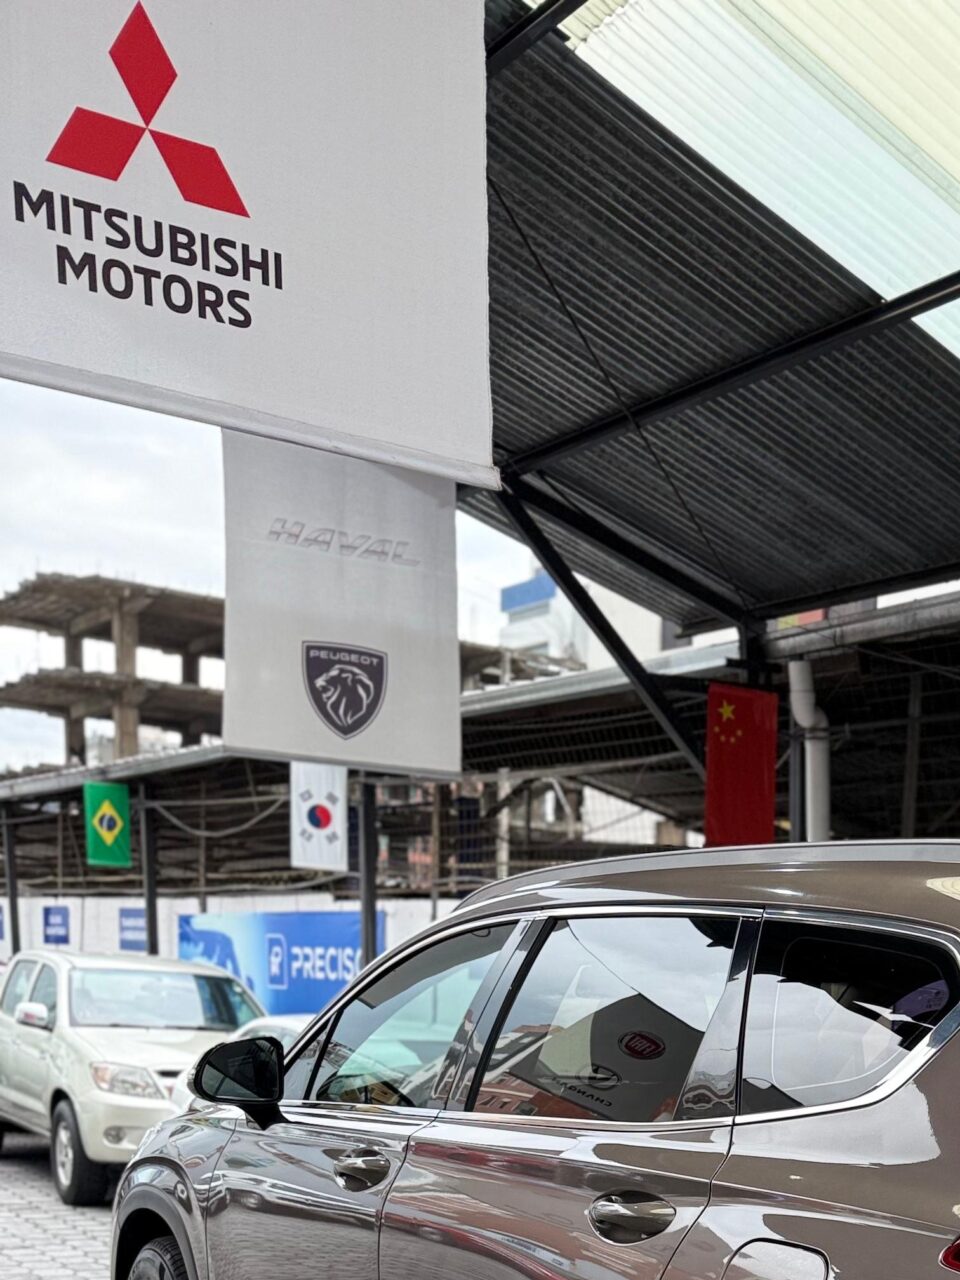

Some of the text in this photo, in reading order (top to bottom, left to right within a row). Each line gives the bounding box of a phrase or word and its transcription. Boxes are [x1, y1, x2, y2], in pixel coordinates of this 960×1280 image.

[13, 180, 283, 290] MITSUBISHI
[56, 244, 253, 329] MOTORS
[266, 517, 421, 567] HAVAL
[309, 648, 380, 666] PEUGEOT
